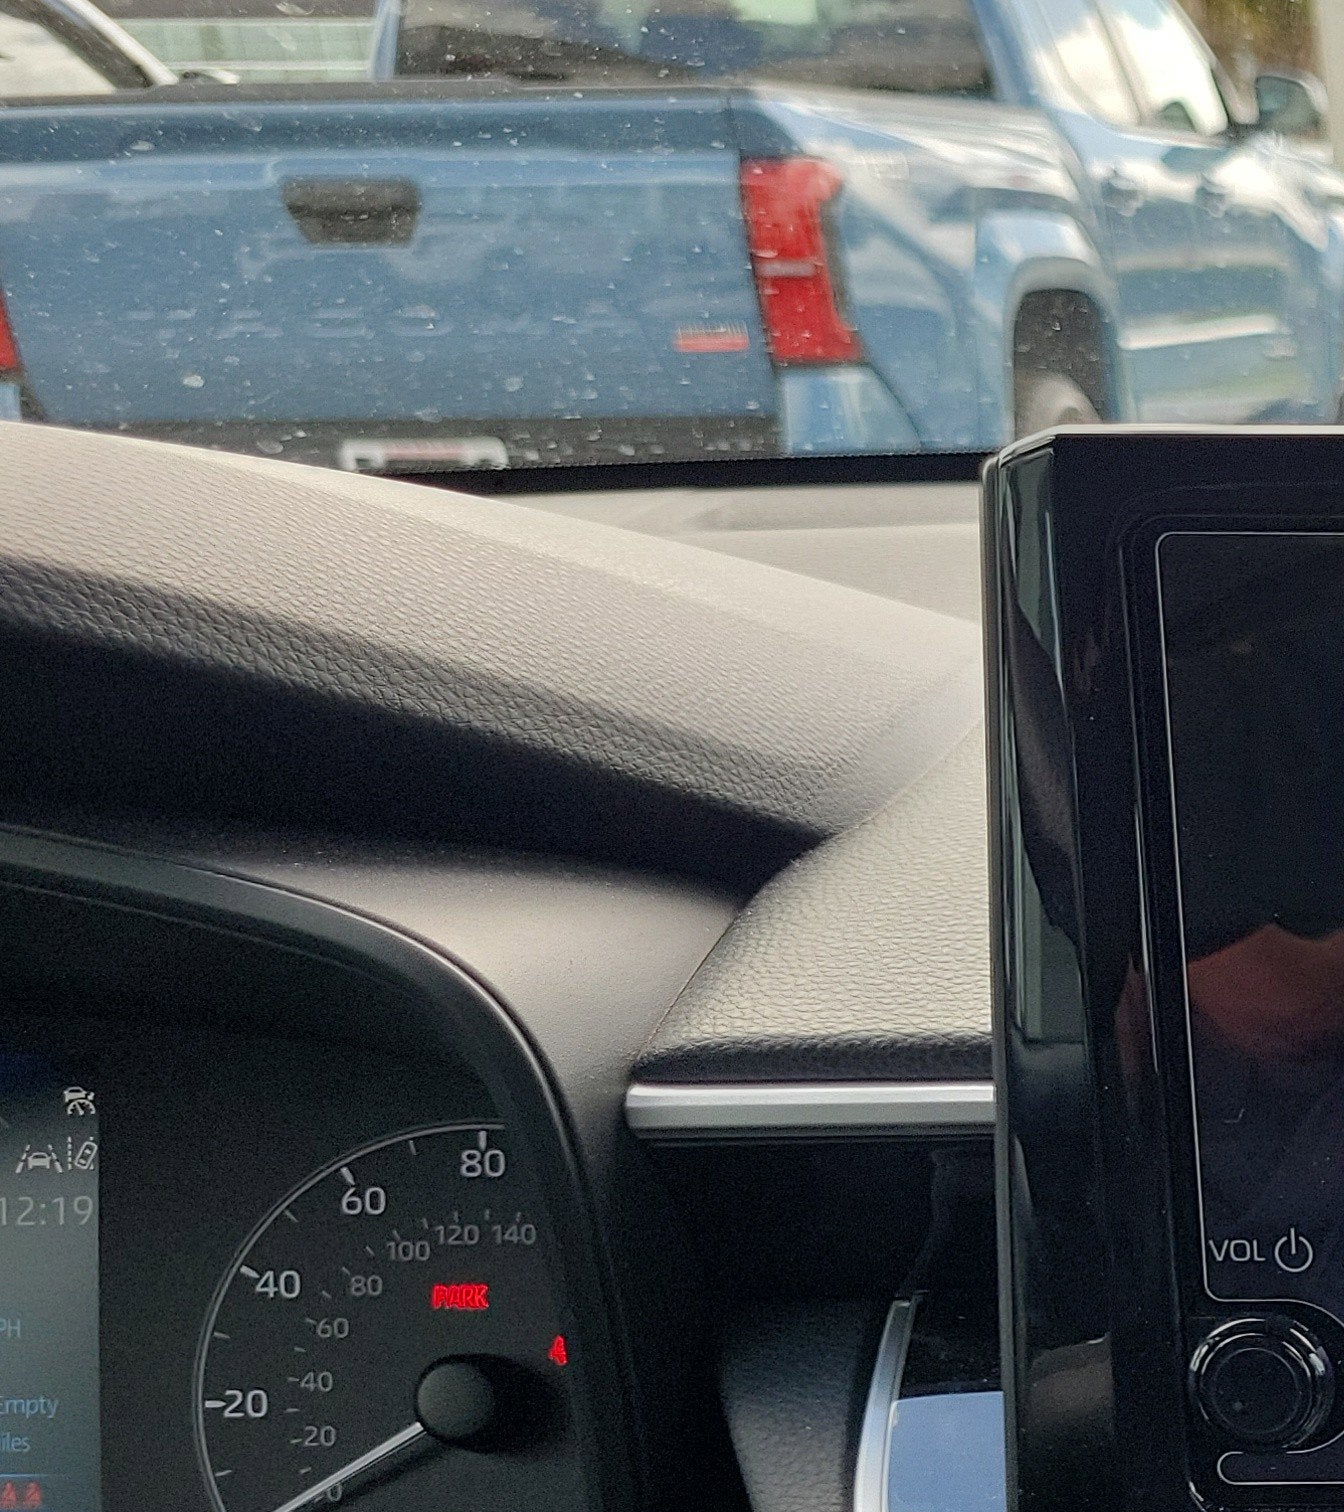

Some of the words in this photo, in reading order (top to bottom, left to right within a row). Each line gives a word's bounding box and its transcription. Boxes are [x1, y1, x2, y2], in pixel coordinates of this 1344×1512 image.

[460, 1149, 505, 1177] 80
[341, 1187, 386, 1215] 60
[435, 1224, 479, 1246] 120
[493, 1224, 537, 1246] 140
[386, 1240, 430, 1262] 100
[1209, 1239, 1266, 1261] VOL
[256, 1270, 301, 1299] 40
[350, 1275, 382, 1297] 80
[432, 1284, 489, 1309] PARK
[316, 1317, 349, 1339] 60
[301, 1371, 333, 1392] 40
[223, 1390, 268, 1418] 20
[304, 1426, 336, 1447] 20
